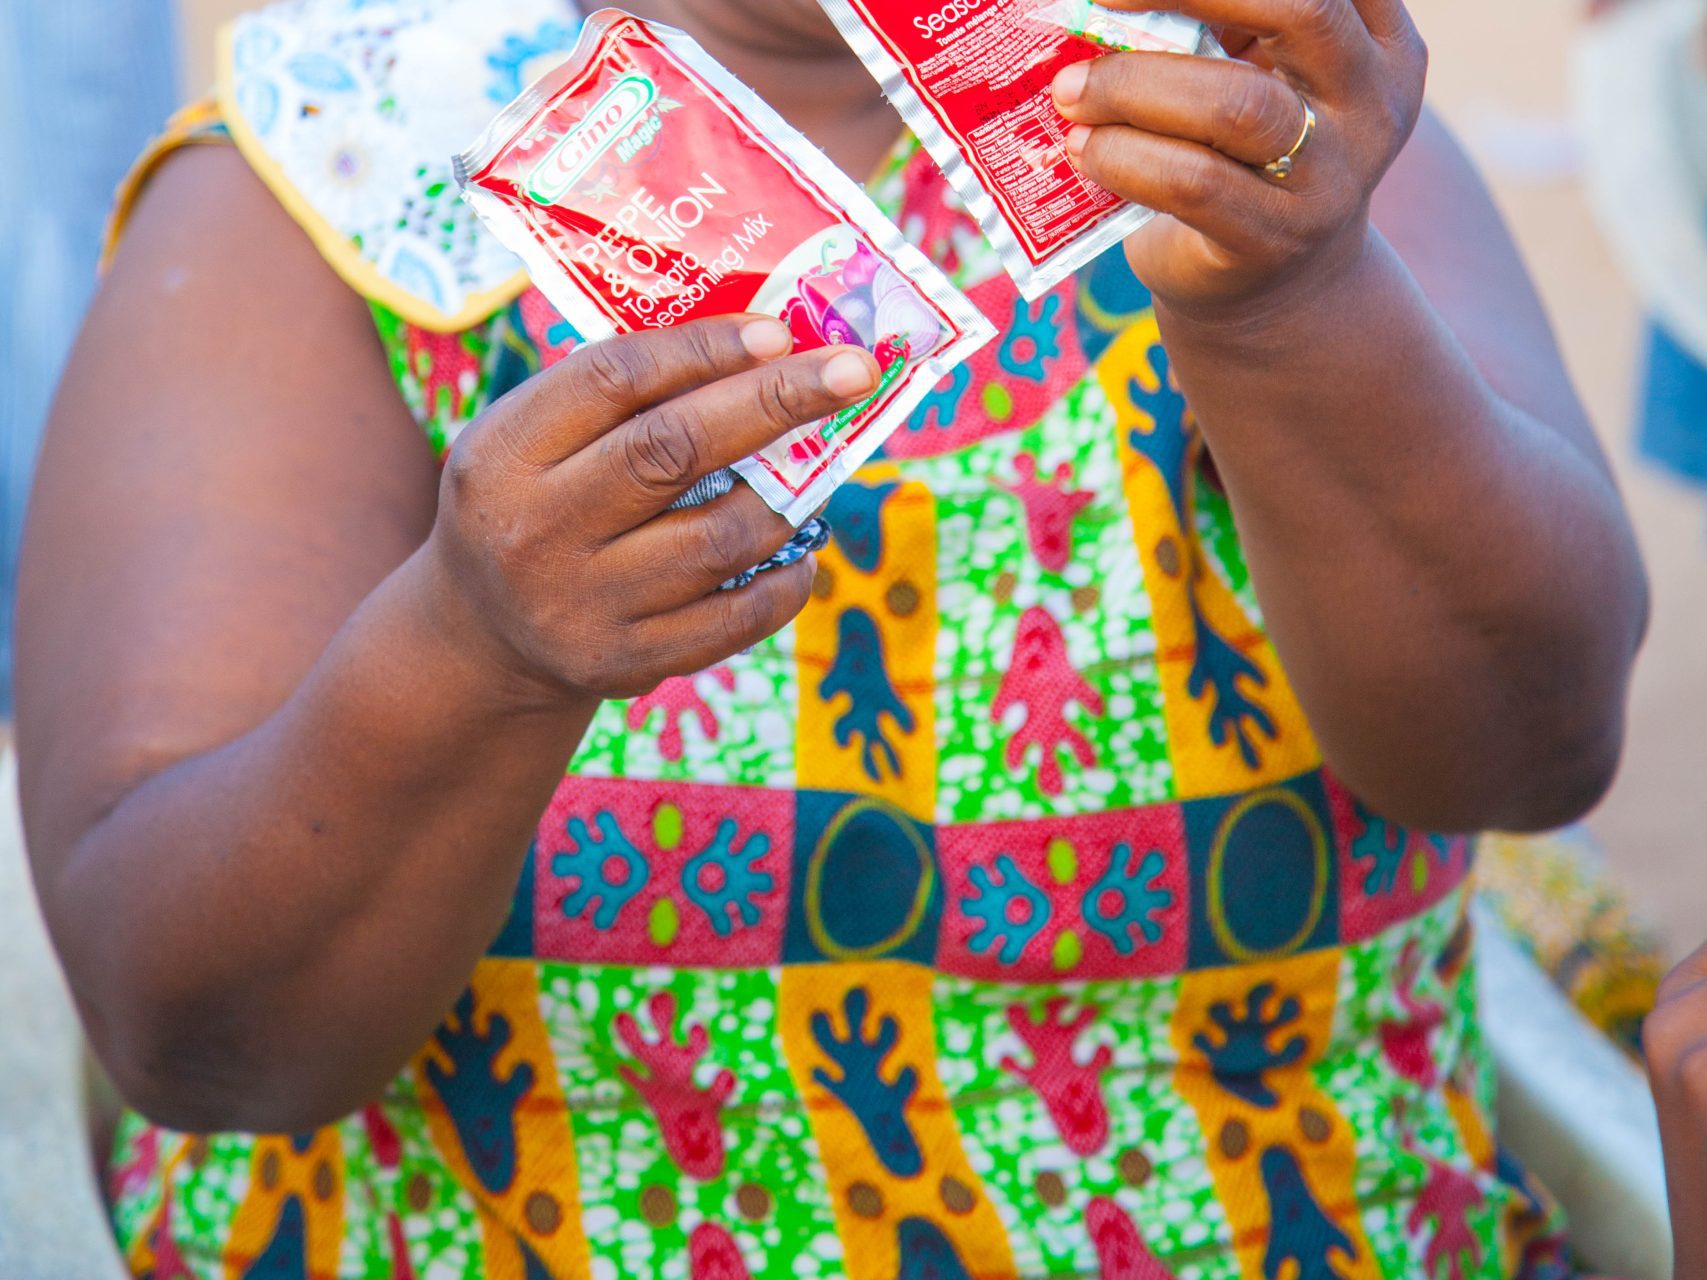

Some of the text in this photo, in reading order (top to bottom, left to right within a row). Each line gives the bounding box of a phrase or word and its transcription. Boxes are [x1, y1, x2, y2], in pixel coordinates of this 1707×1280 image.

[936, 26, 965, 46] Tomate
[965, 4, 997, 29] mélange
[558, 106, 619, 169] Gino
[616, 115, 661, 162] Magic
[973, 115, 1002, 137] Nutritional
[1001, 98, 1034, 124] Information
[974, 126, 1005, 148] Information
[577, 188, 663, 273] PEPPE
[604, 173, 726, 297] & ONION
[625, 250, 701, 319] Tomato
[643, 214, 772, 329] Seasoning Mix
